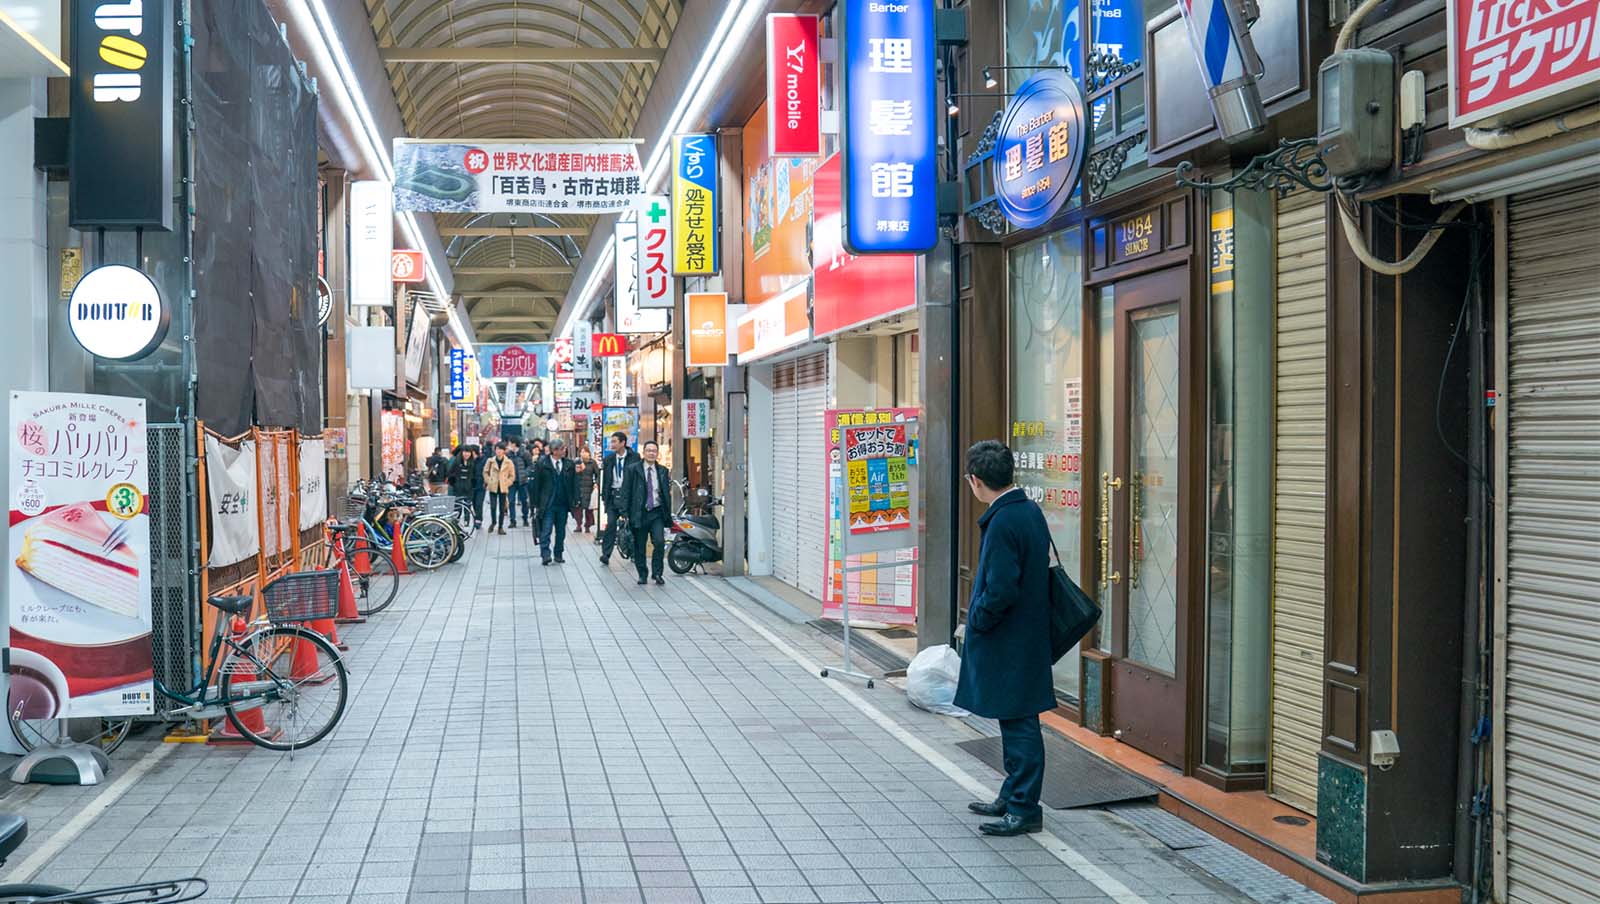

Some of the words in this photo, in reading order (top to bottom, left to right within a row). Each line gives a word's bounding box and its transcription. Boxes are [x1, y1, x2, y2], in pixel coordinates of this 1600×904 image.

[869, 3, 909, 13] Barber
[1017, 123, 1030, 137] The
[1028, 110, 1055, 132] Barber
[469, 154, 485, 168] 祝
[493, 152, 640, 172] 世界文化遺産国内推薦決
[684, 138, 706, 178] くすり
[1022, 185, 1037, 199] since
[1037, 175, 1052, 192] 1954
[685, 188, 705, 270] 処方せん受付
[876, 220, 910, 232] 堺東店
[1121, 212, 1153, 242] 1954
[1124, 238, 1149, 256] SINCE
[645, 228, 668, 299] クスリ
[33, 403, 67, 419] SAKURA
[70, 402, 97, 410] MILLE
[21, 424, 46, 455] 桜の
[51, 425, 128, 460] パリパリ
[856, 428, 896, 441] セットで
[847, 442, 905, 460] お得おうち割
[22, 459, 138, 480] チョコミルクレープ
[870, 471, 886, 483] Air
